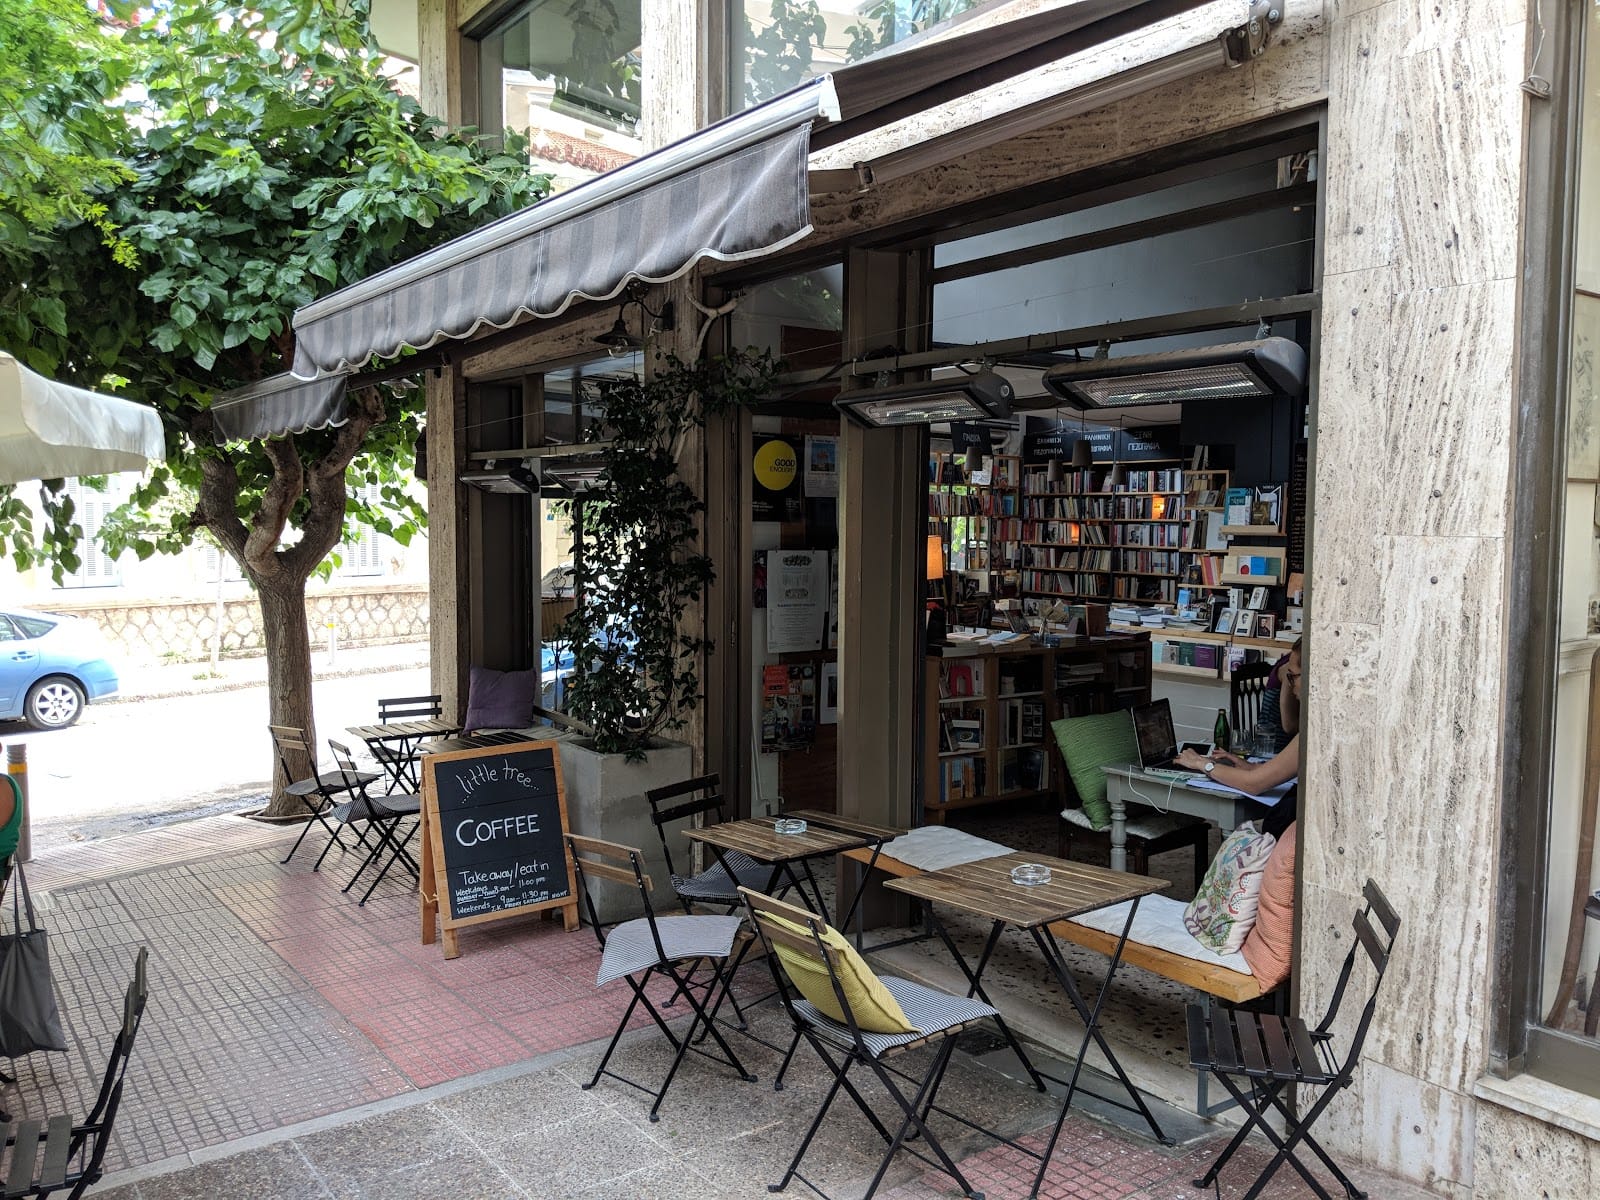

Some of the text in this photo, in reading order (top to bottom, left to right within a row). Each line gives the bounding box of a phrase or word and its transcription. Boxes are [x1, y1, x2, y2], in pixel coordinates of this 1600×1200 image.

[775, 458, 795, 467] GOOD
[456, 814, 540, 847] COFFEE
[540, 862, 549, 871] in
[455, 885, 488, 897] Weekdays
[535, 876, 545, 885] pm
